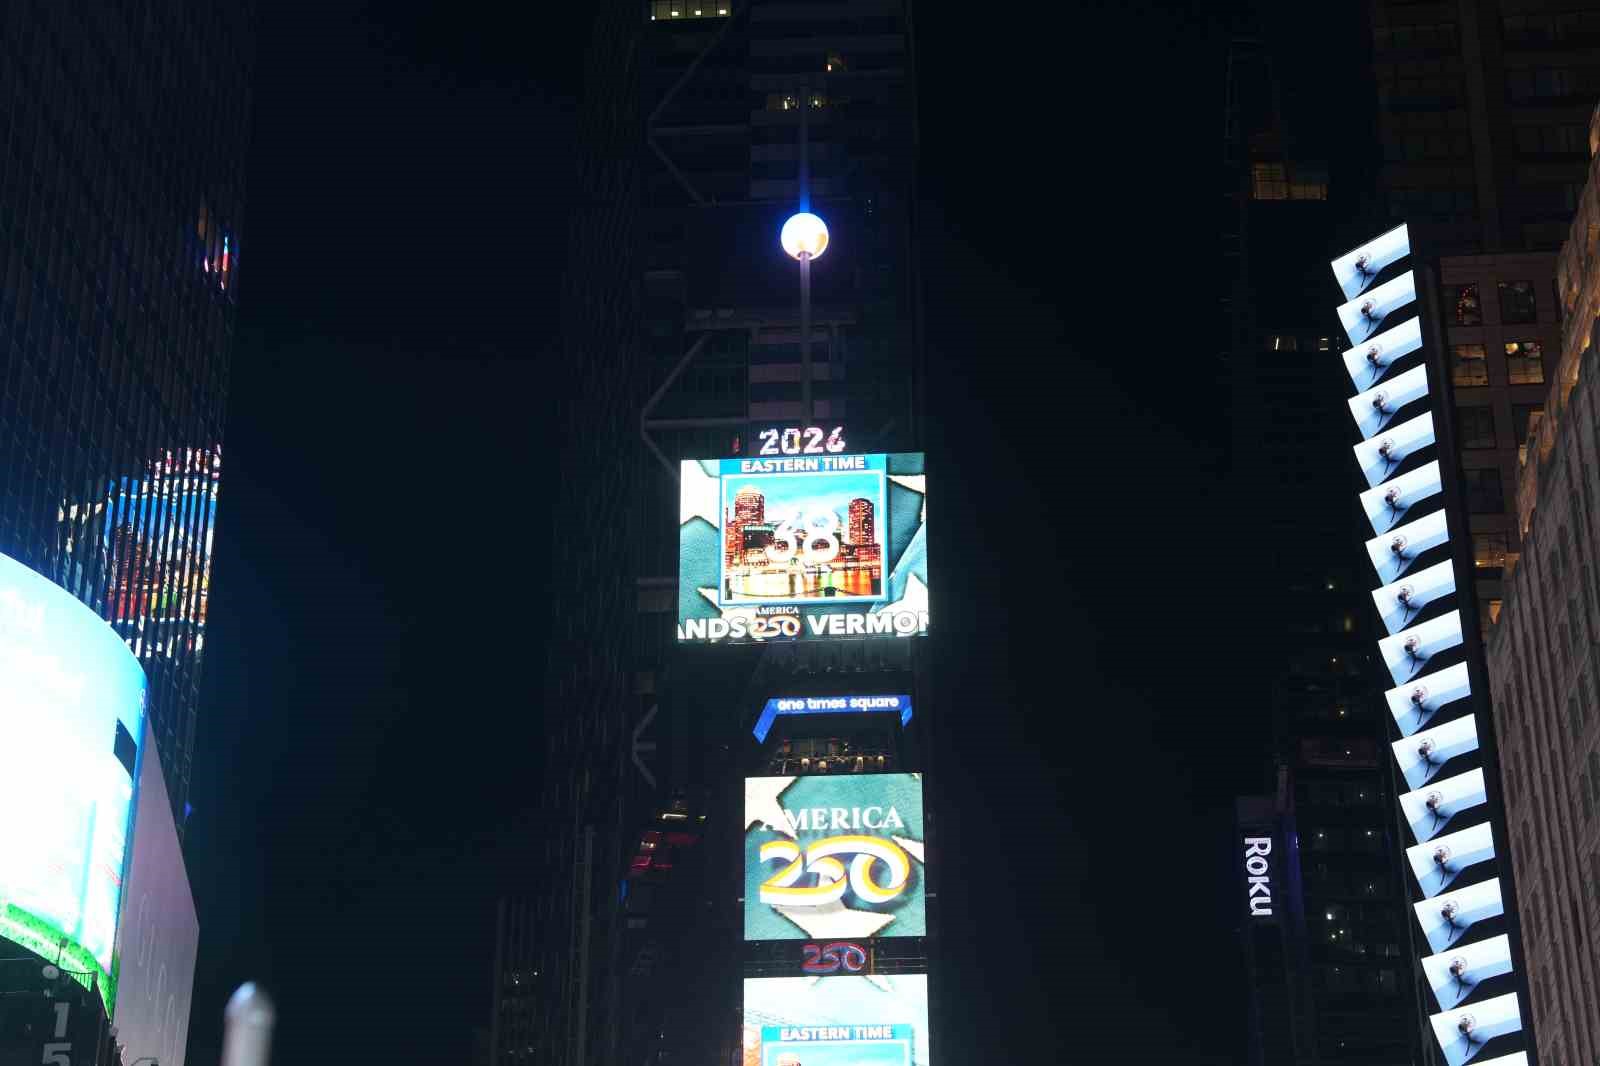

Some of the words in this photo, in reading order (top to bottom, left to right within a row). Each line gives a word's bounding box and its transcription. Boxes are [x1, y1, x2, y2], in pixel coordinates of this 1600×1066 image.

[760, 427, 845, 455] 2026
[741, 457, 819, 473] EASTERN
[823, 455, 865, 470] TIME
[750, 615, 801, 638] 250
[777, 699, 805, 711] one
[807, 698, 846, 709] times
[850, 697, 900, 711] square
[760, 834, 911, 906] 250
[1244, 837, 1273, 916] ROKU
[801, 942, 867, 972] 250
[780, 1026, 850, 1041] EASTERN
[855, 1025, 893, 1039] TIME
